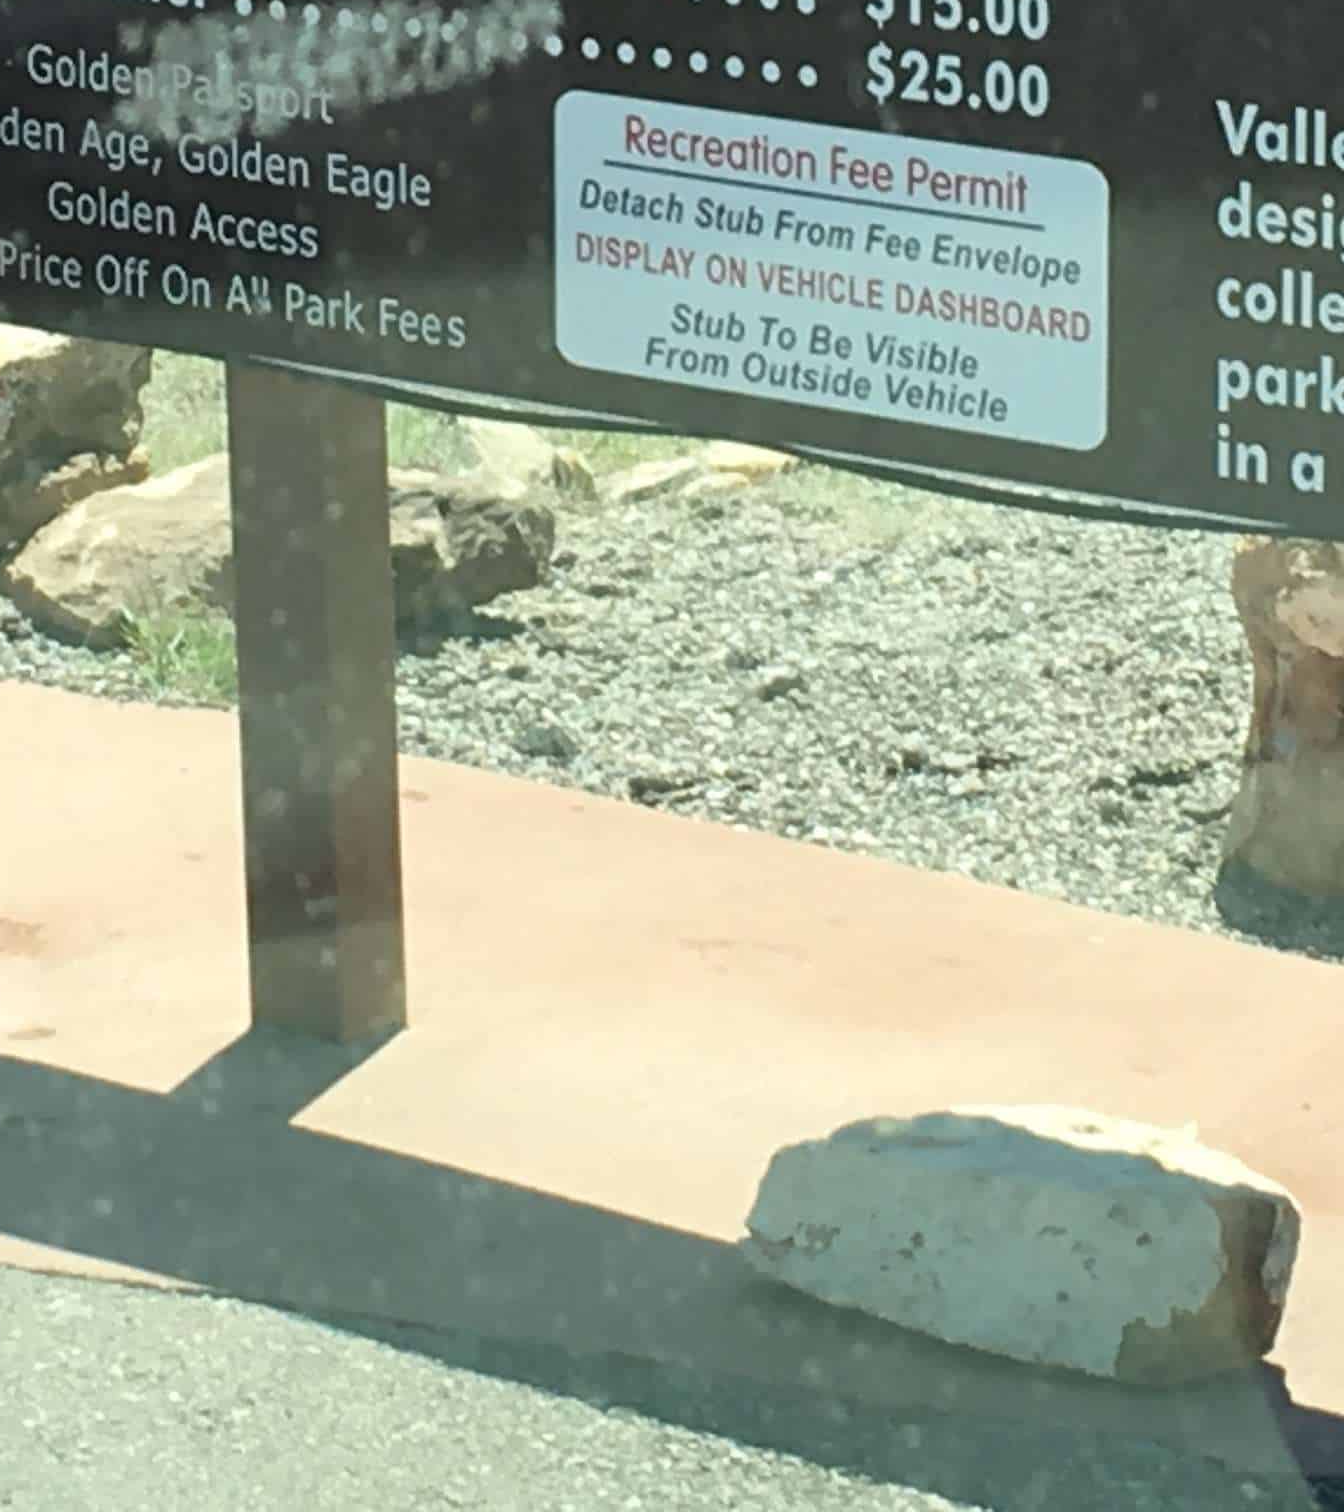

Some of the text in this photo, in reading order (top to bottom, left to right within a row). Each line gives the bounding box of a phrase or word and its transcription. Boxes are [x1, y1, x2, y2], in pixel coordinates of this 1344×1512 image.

[26, 43, 335, 125] Golden Pasport
[865, 40, 1050, 118] $25.00
[80, 120, 162, 176] Age,
[177, 136, 311, 189] Golden
[327, 153, 432, 211] Eagle
[625, 114, 1029, 213] Recreation Fee Permit
[48, 182, 320, 260] Golden Access
[580, 179, 1082, 286] Detach Stub From Fee Envelope
[96, 254, 150, 297] Off
[161, 265, 212, 308] On
[226, 275, 271, 314] All
[285, 285, 364, 336] Park
[379, 297, 467, 348] Fees
[576, 233, 1092, 343] DISPLAY ON VEHICLE DASHBOARD
[644, 338, 1009, 423] From Outside Vehicle
[671, 304, 979, 379] Stub To Be Visible
[1217, 423, 1268, 485] in
[1291, 451, 1325, 493] a
